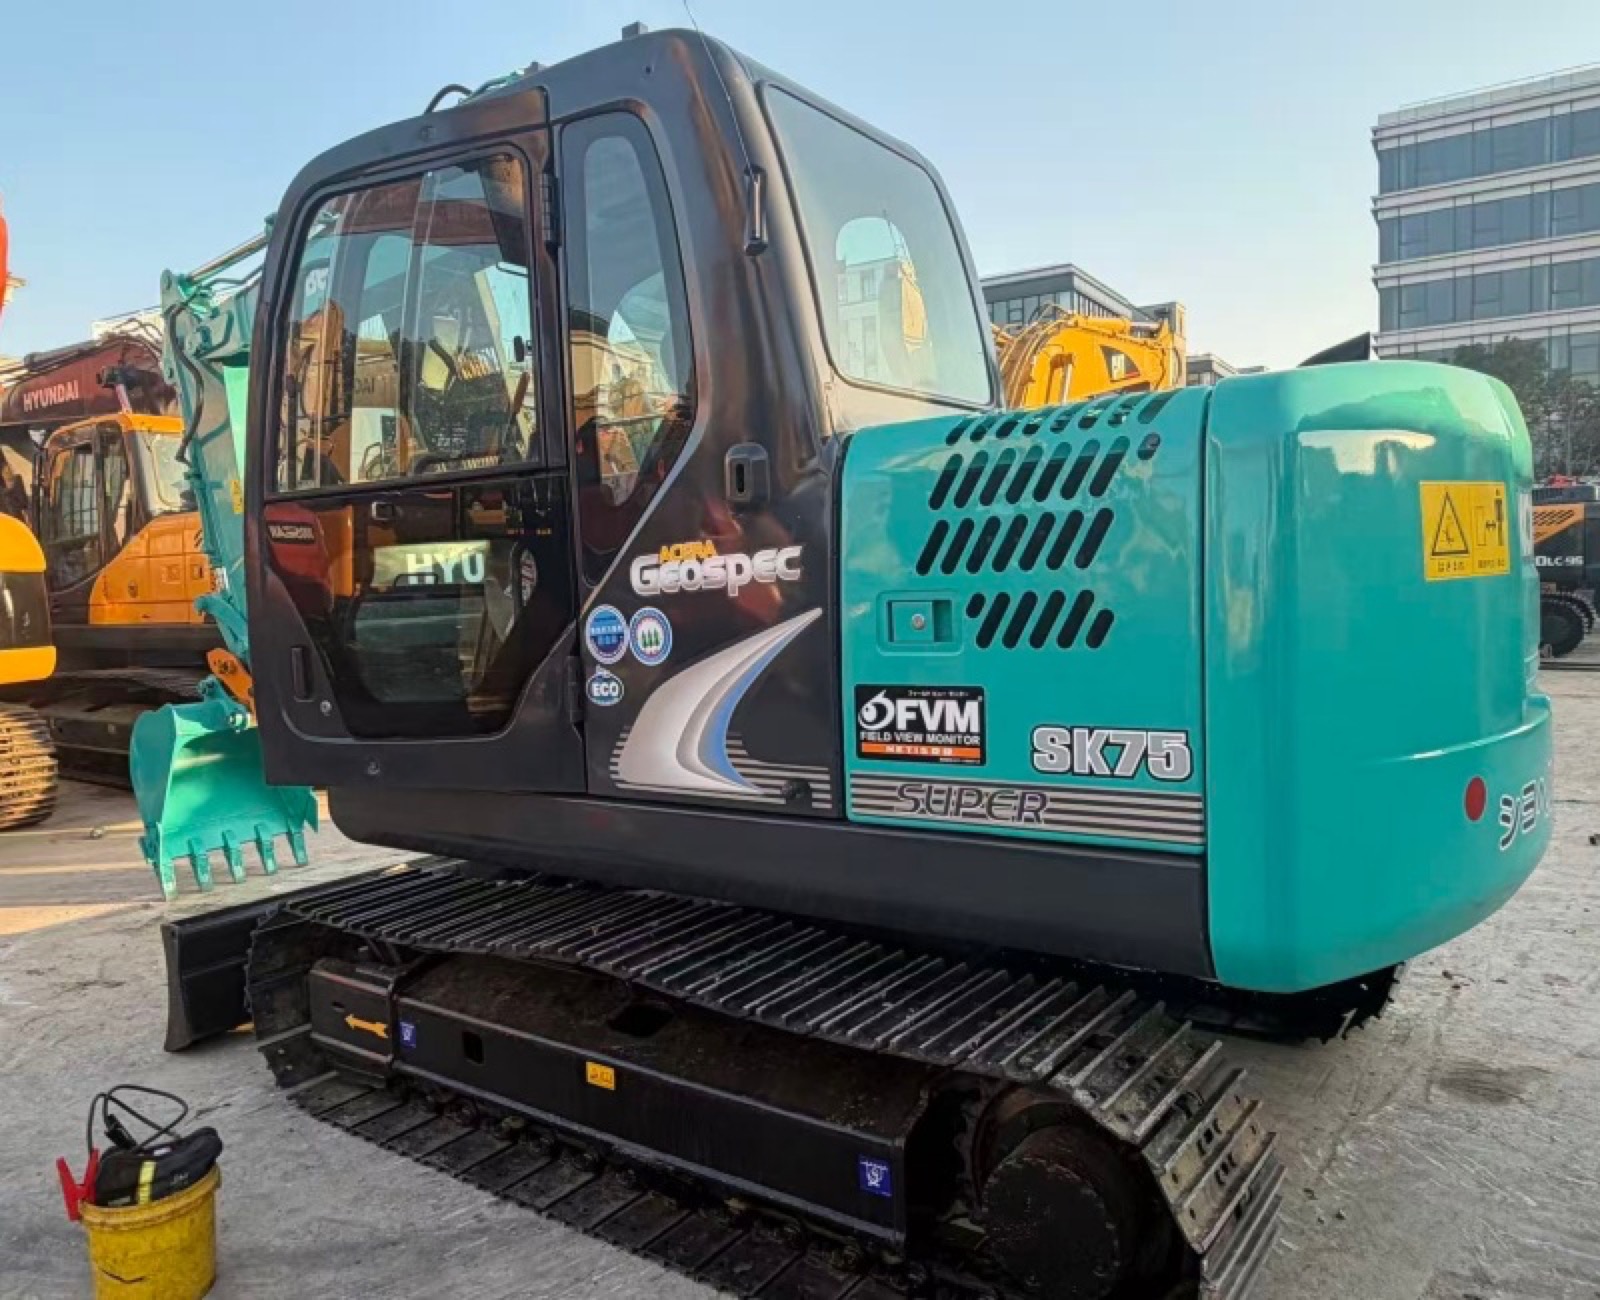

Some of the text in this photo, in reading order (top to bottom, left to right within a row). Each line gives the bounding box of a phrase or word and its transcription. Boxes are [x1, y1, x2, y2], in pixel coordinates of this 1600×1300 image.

[23, 379, 79, 412] HYUNDAI
[406, 553, 485, 584] HYU
[896, 698, 979, 733] FVM
[860, 731, 981, 746] FIELD VIEW MONITOR
[1031, 724, 1194, 782] SK75
[897, 783, 1050, 824] SUPER
